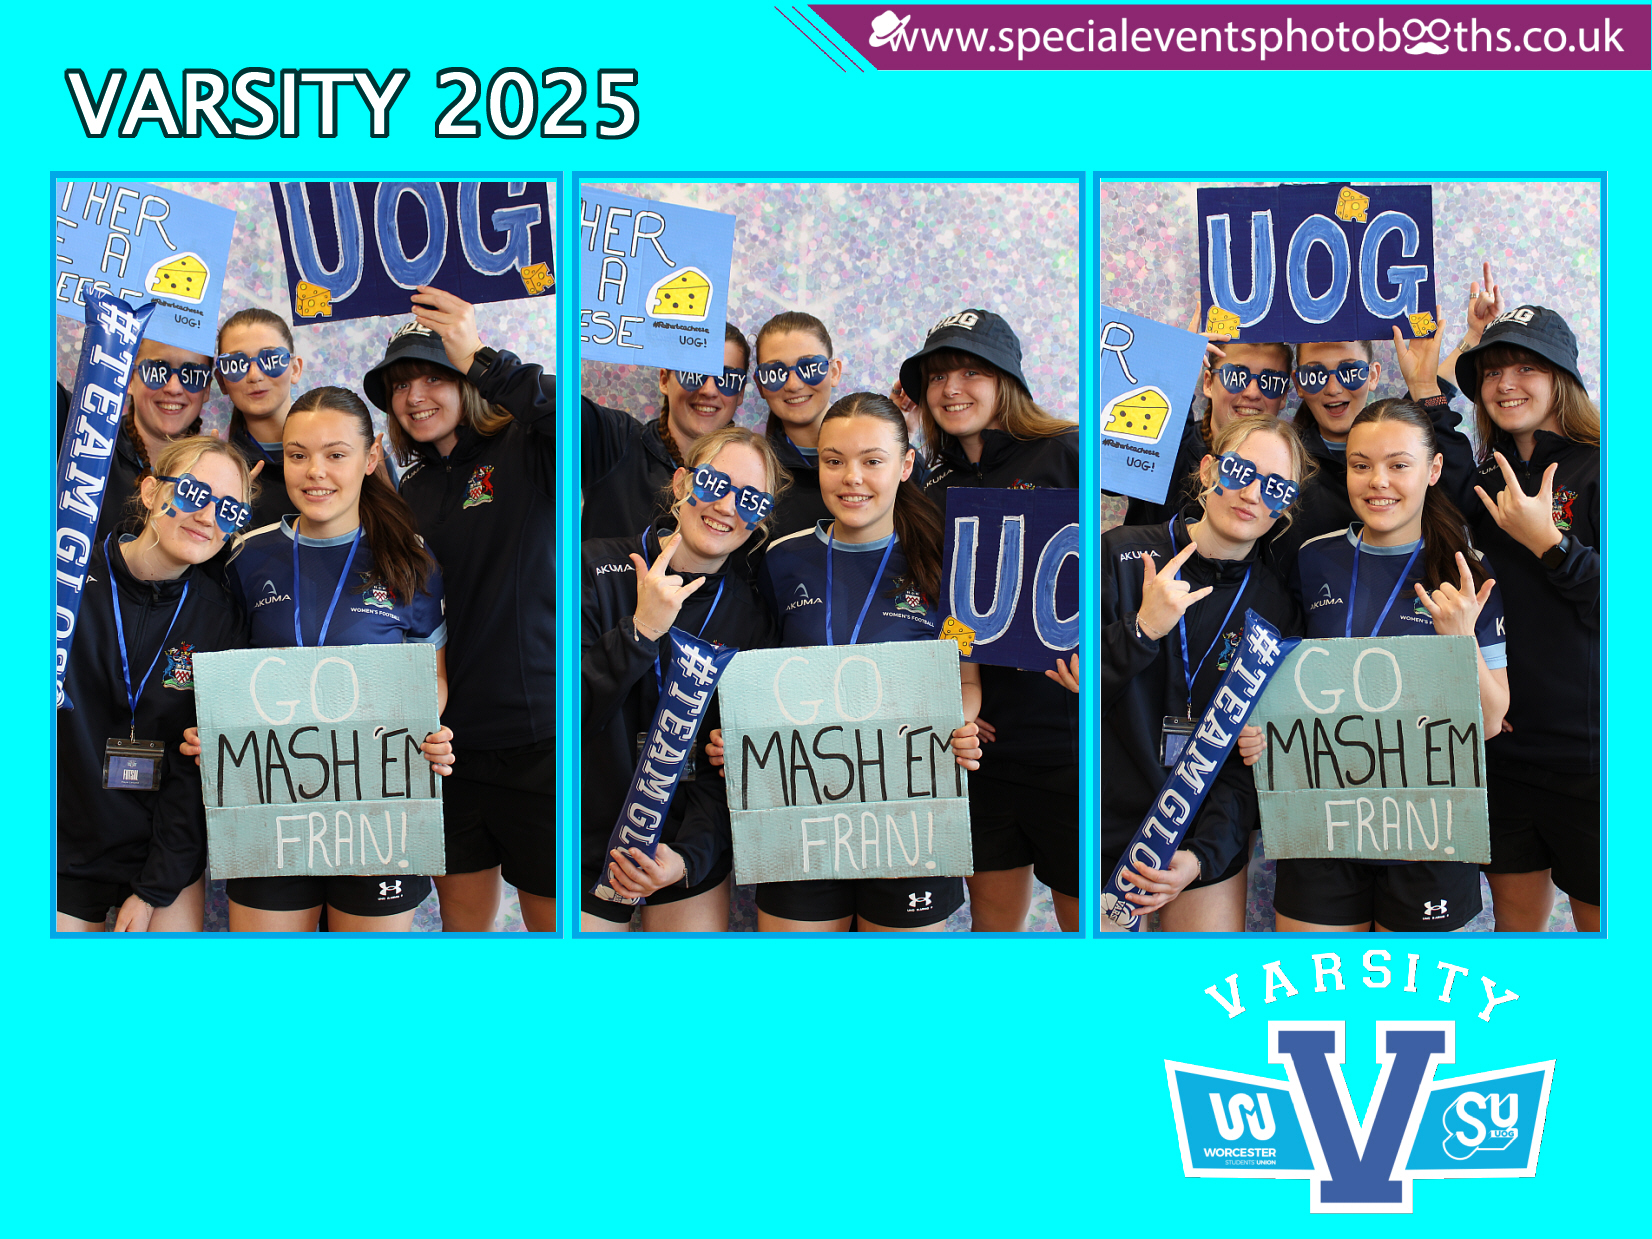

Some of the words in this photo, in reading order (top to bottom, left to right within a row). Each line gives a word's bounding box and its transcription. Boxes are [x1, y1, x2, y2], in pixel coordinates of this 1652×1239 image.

[101, 232, 131, 279] A
[280, 182, 542, 304] UOG
[598, 256, 628, 305] A
[1206, 209, 1429, 328] UOG
[174, 313, 201, 329] UOG!
[679, 335, 708, 349] UOG!
[141, 364, 168, 385] VAR
[180, 367, 211, 388] SITY
[219, 358, 249, 375] UOG
[259, 353, 289, 372] WFC
[758, 367, 788, 386] UOG
[798, 361, 828, 380] WFC
[1222, 368, 1247, 389] VAR
[1260, 374, 1289, 395] SITY
[1298, 370, 1328, 387] UOG
[1338, 367, 1368, 385] WFC
[1126, 455, 1155, 473] UOG!
[1220, 456, 1254, 486] CHE
[1264, 476, 1296, 506] ESE
[177, 478, 210, 508] CHE
[219, 499, 250, 528] ESE
[695, 468, 729, 498] CHE
[739, 489, 771, 518] ESE
[595, 562, 636, 577] AKUMA
[253, 593, 292, 609] AKUMA
[350, 606, 379, 616] WOMEN'S
[785, 597, 824, 611] AKUMA
[882, 610, 911, 621] WOMEN'S
[911, 615, 935, 628] FOOTBALL
[1309, 596, 1344, 611] AKUMA
[1400, 614, 1430, 625] WOMEN'S
[250, 656, 360, 725] GO
[773, 655, 884, 726] GO
[1293, 646, 1403, 714] GO
[217, 726, 363, 807] MASH
[741, 726, 887, 810] MASH
[1266, 715, 1408, 791] MASH
[1416, 716, 1481, 788] 'EM
[275, 810, 409, 870] FRAN!
[800, 811, 938, 873] FRAN!
[1324, 797, 1456, 855] FRAN!
